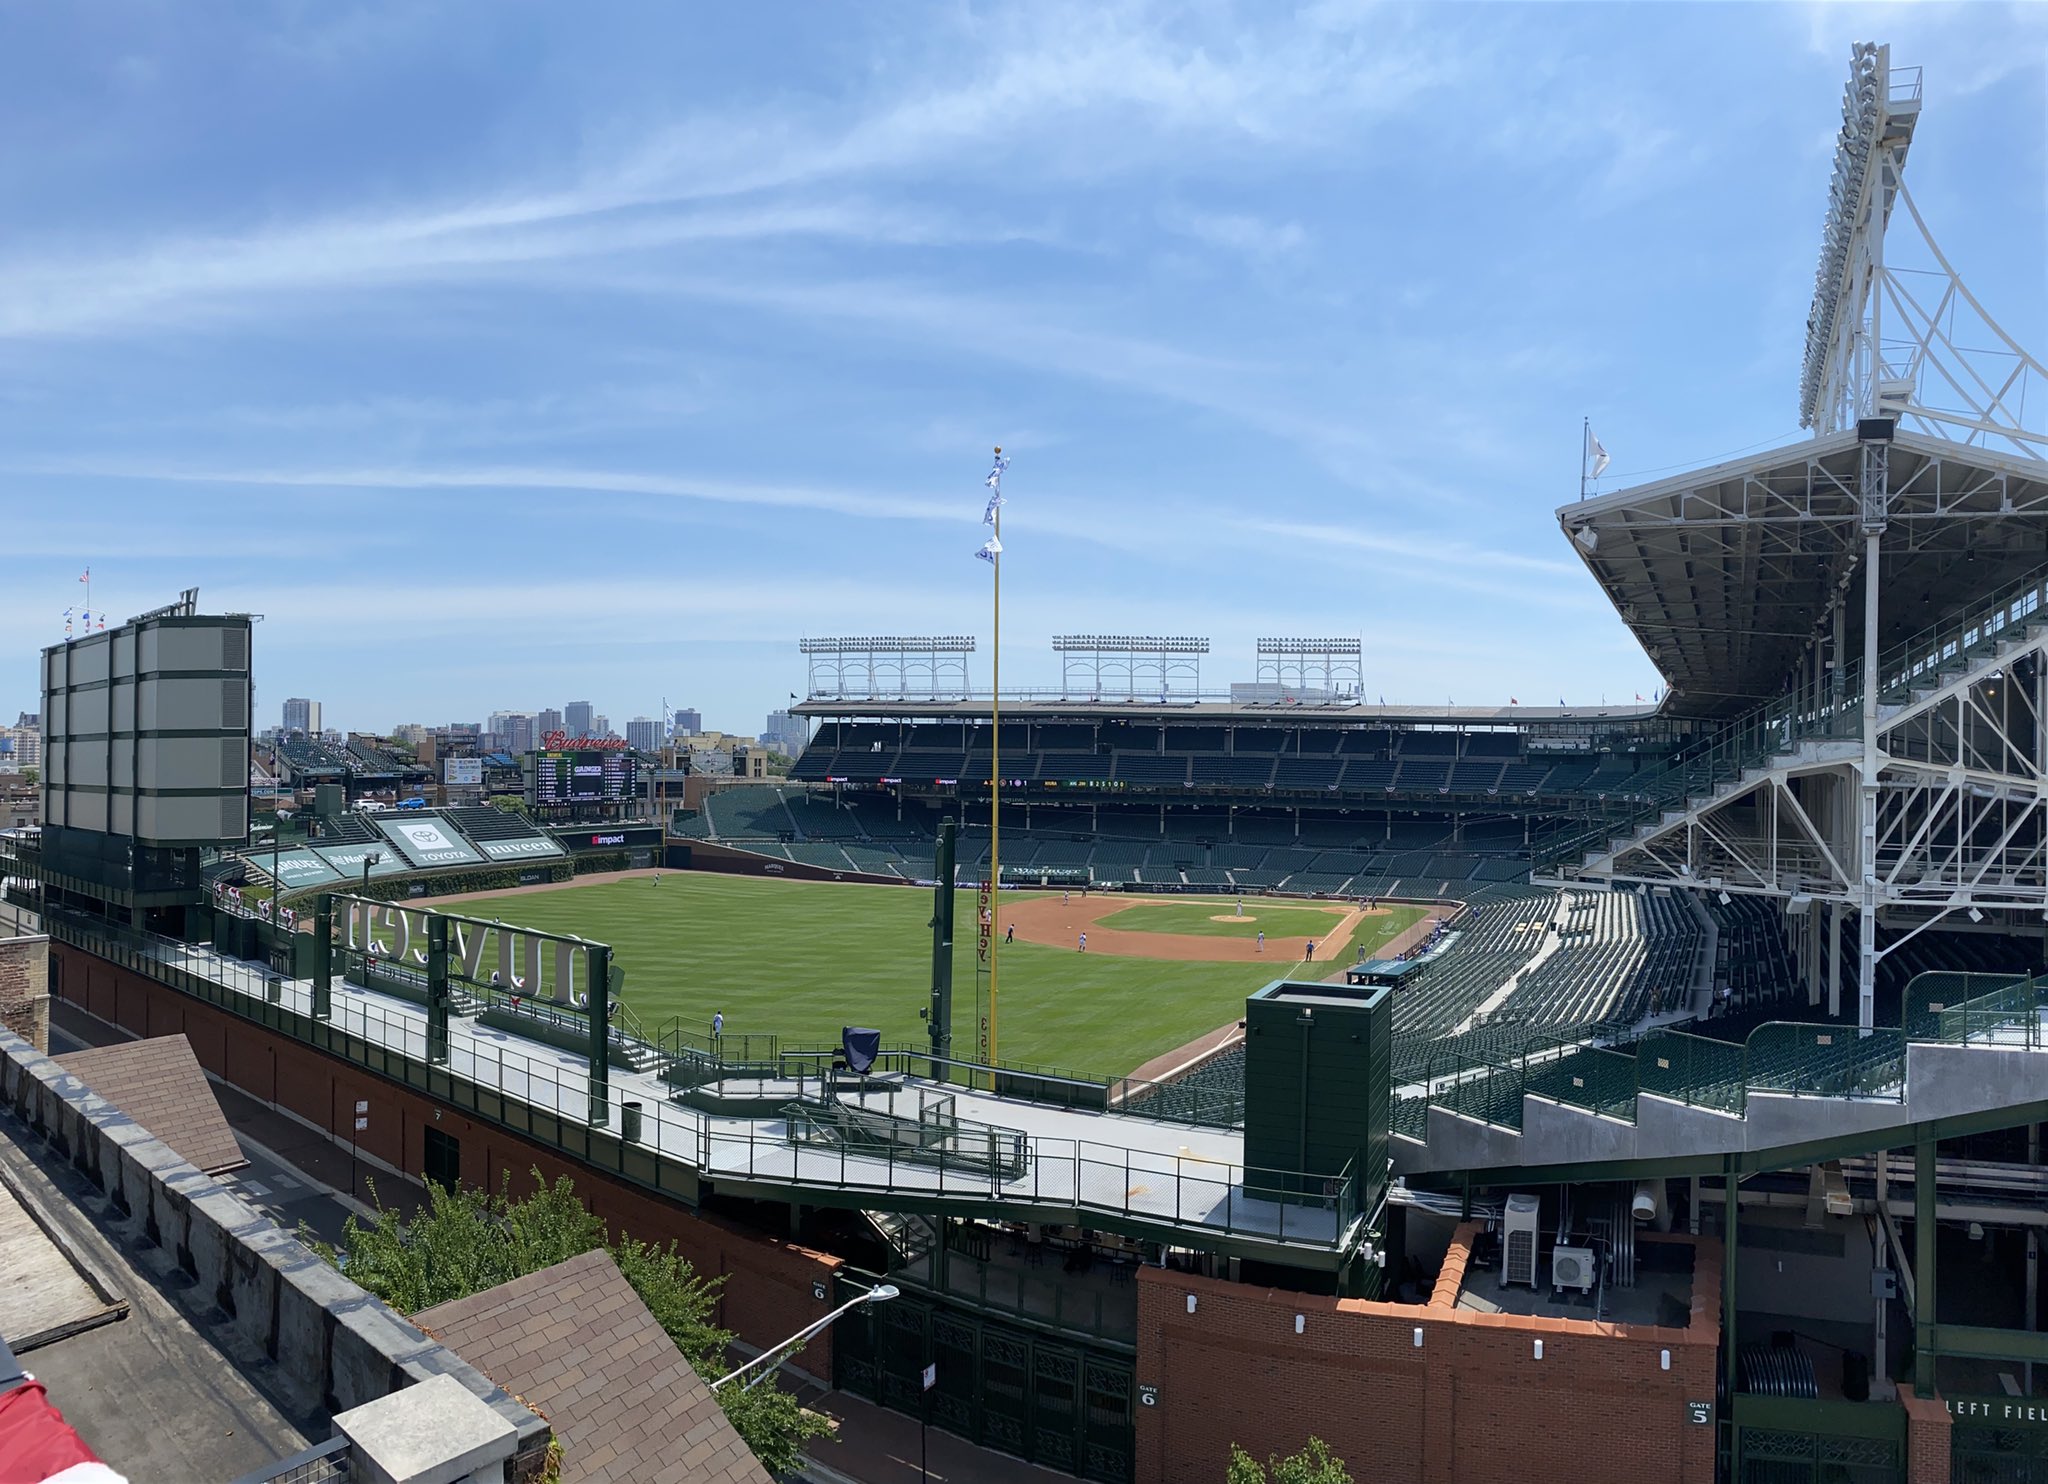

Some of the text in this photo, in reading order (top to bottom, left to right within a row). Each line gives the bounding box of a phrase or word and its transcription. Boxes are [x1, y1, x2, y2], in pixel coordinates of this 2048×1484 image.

[541, 730, 628, 750] Budweiser
[598, 834, 624, 845] impact
[485, 840, 555, 854] nuveen
[419, 851, 469, 862] TOYOTA
[815, 1288, 824, 1299] 6
[1142, 1393, 1155, 1406] 6
[1692, 1410, 1707, 1423] 5
[1945, 1400, 2048, 1421] LEFT FIEL
